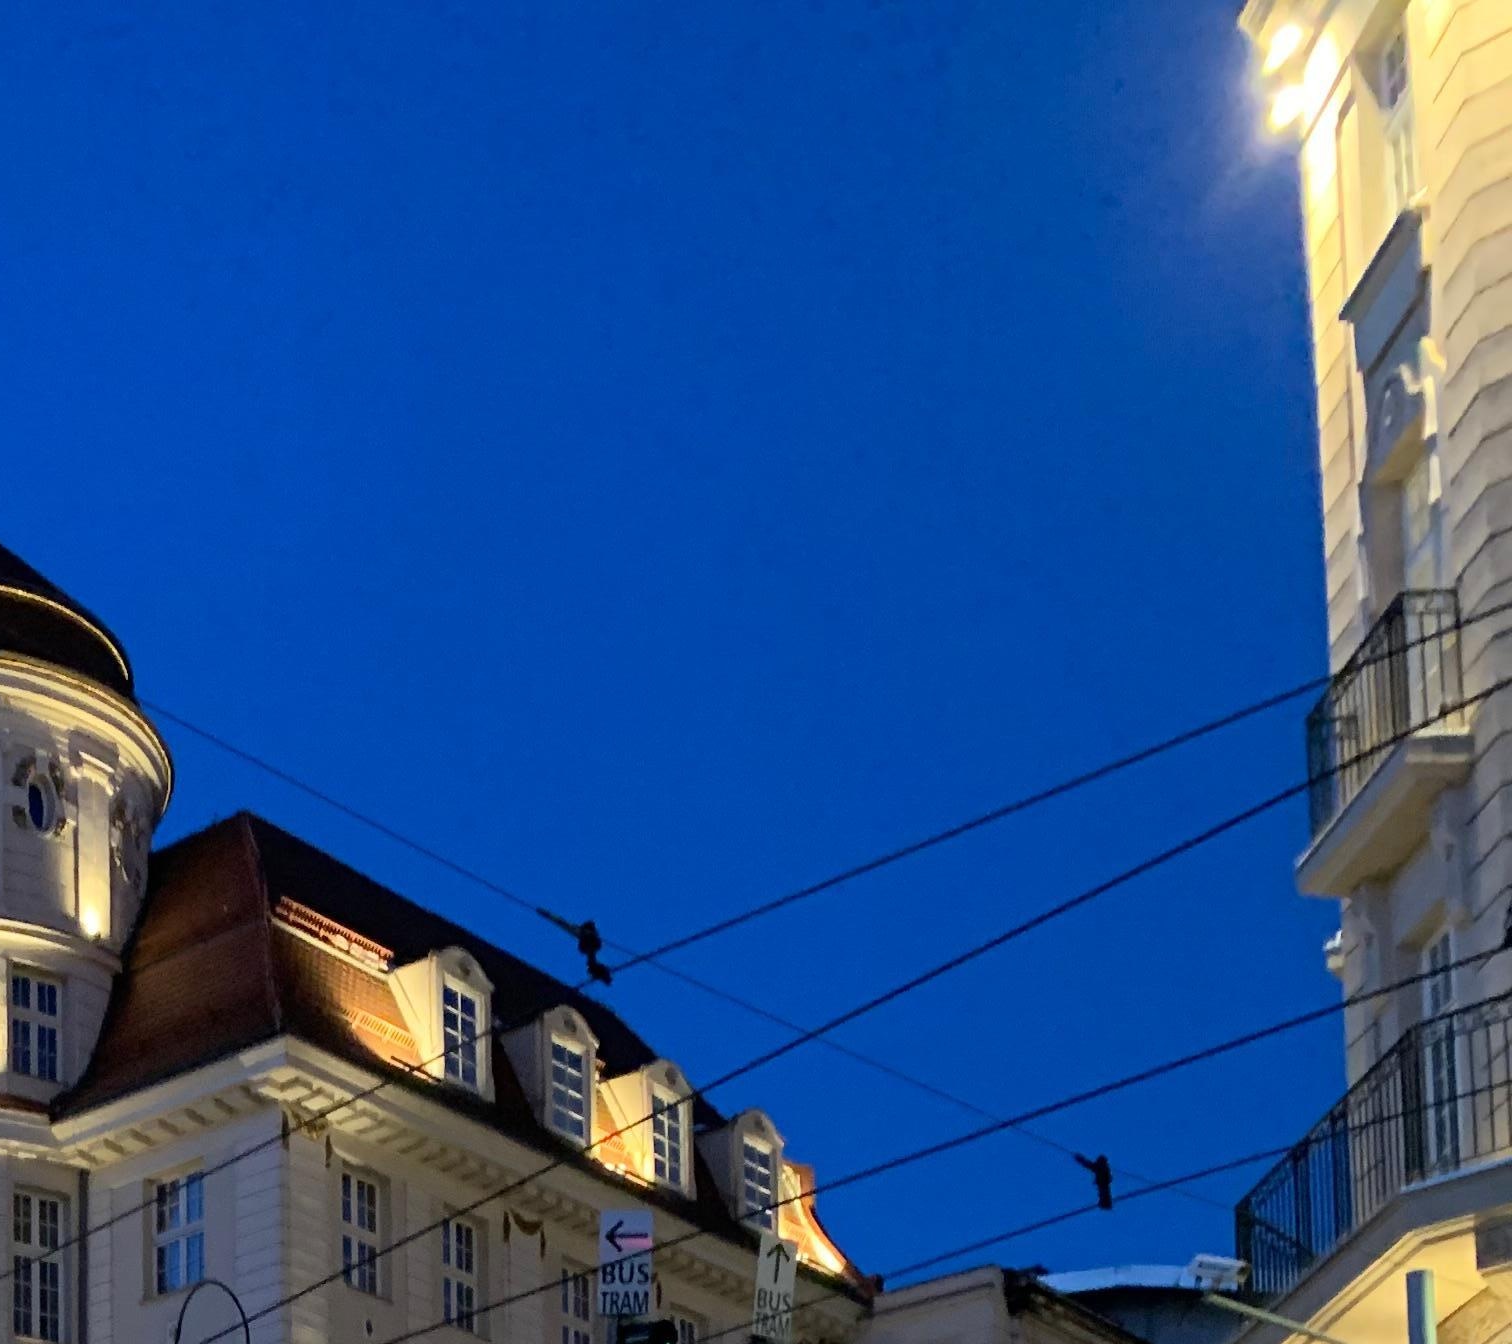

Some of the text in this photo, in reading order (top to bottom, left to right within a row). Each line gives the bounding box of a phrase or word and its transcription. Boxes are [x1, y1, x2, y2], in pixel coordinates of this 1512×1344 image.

[601, 1262, 650, 1285] BUS
[600, 1290, 650, 1315] TRAM
[757, 1287, 792, 1312] BUS
[754, 1311, 791, 1338] TRAM
